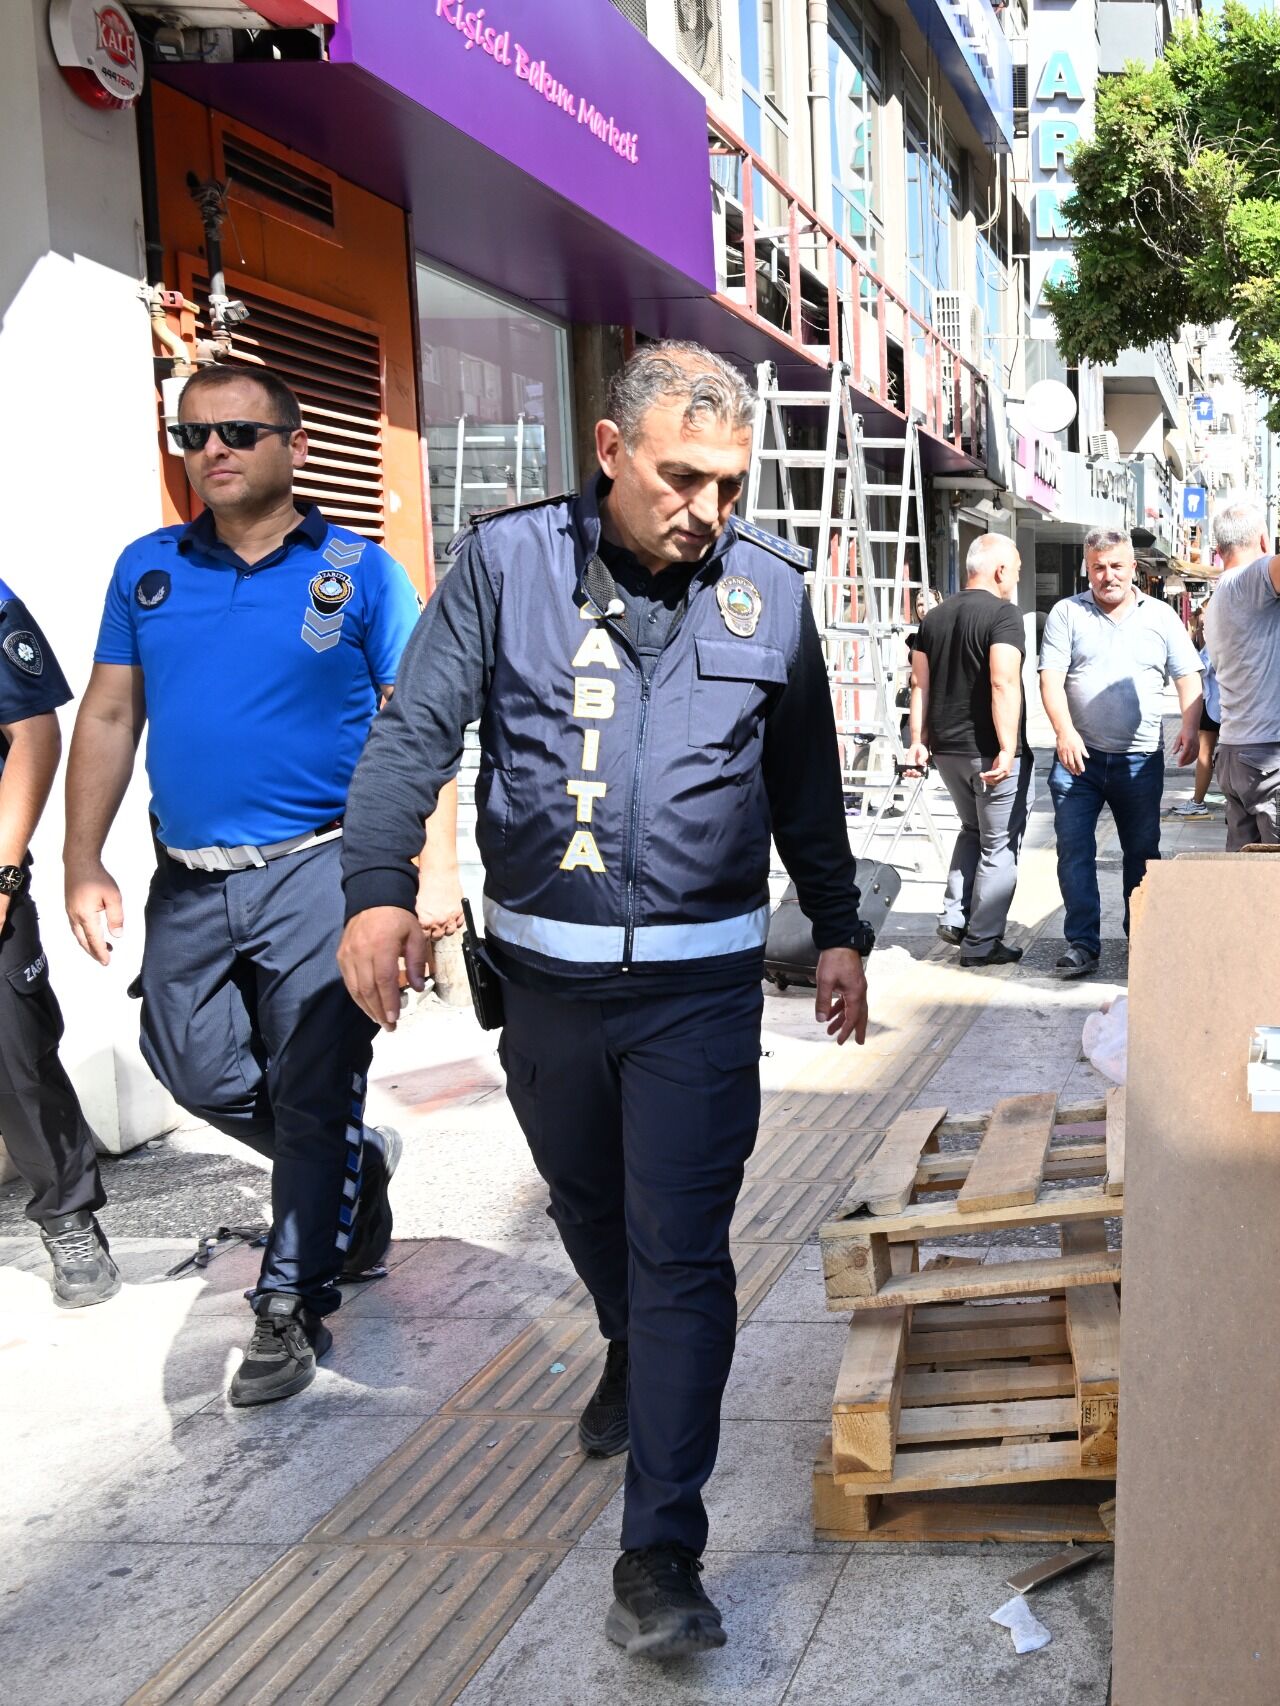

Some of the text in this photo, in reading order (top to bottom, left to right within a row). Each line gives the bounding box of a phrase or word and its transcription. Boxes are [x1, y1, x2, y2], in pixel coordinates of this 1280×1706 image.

[96, 14, 137, 66] KALE
[514, 43, 577, 117] Bakım
[577, 98, 639, 164] Marketi
